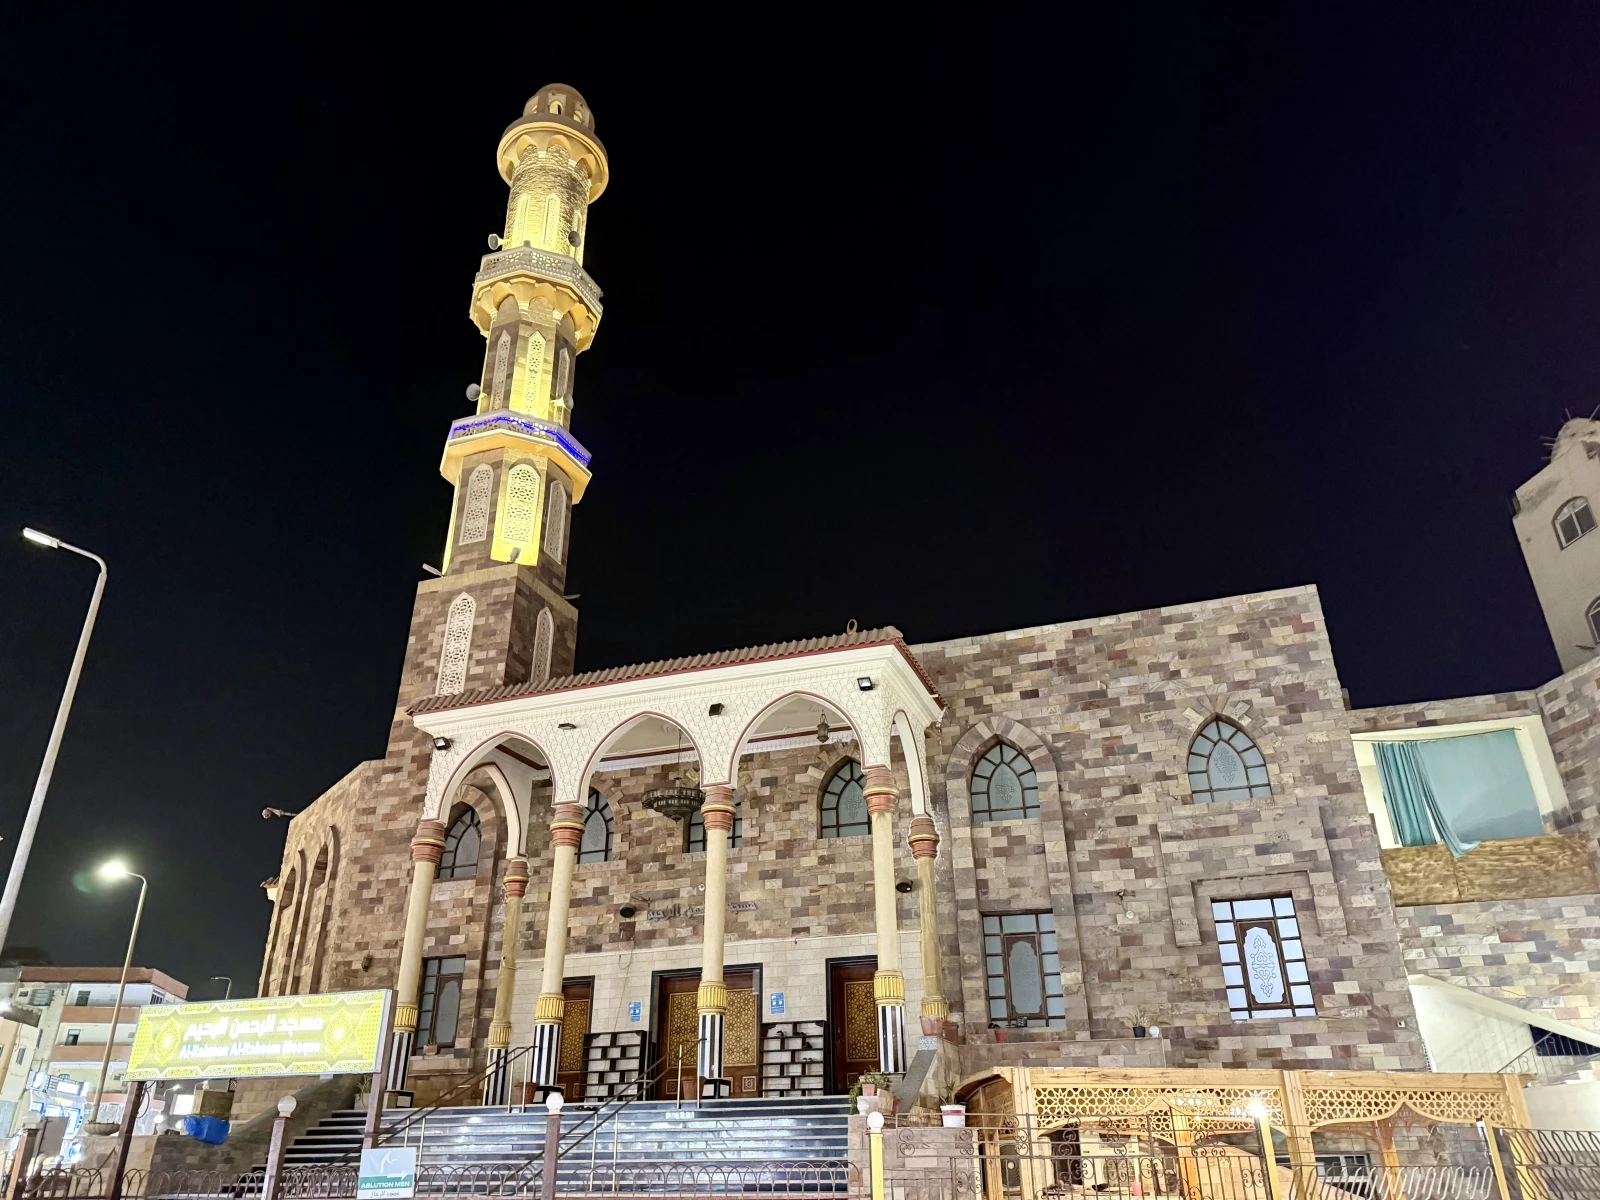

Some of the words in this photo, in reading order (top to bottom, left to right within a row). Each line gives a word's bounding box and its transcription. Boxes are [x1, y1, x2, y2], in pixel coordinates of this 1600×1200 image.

[183, 1016, 229, 1042] الرحيم
[229, 1013, 277, 1039] الرحمن
[277, 1016, 324, 1037] مسجد
